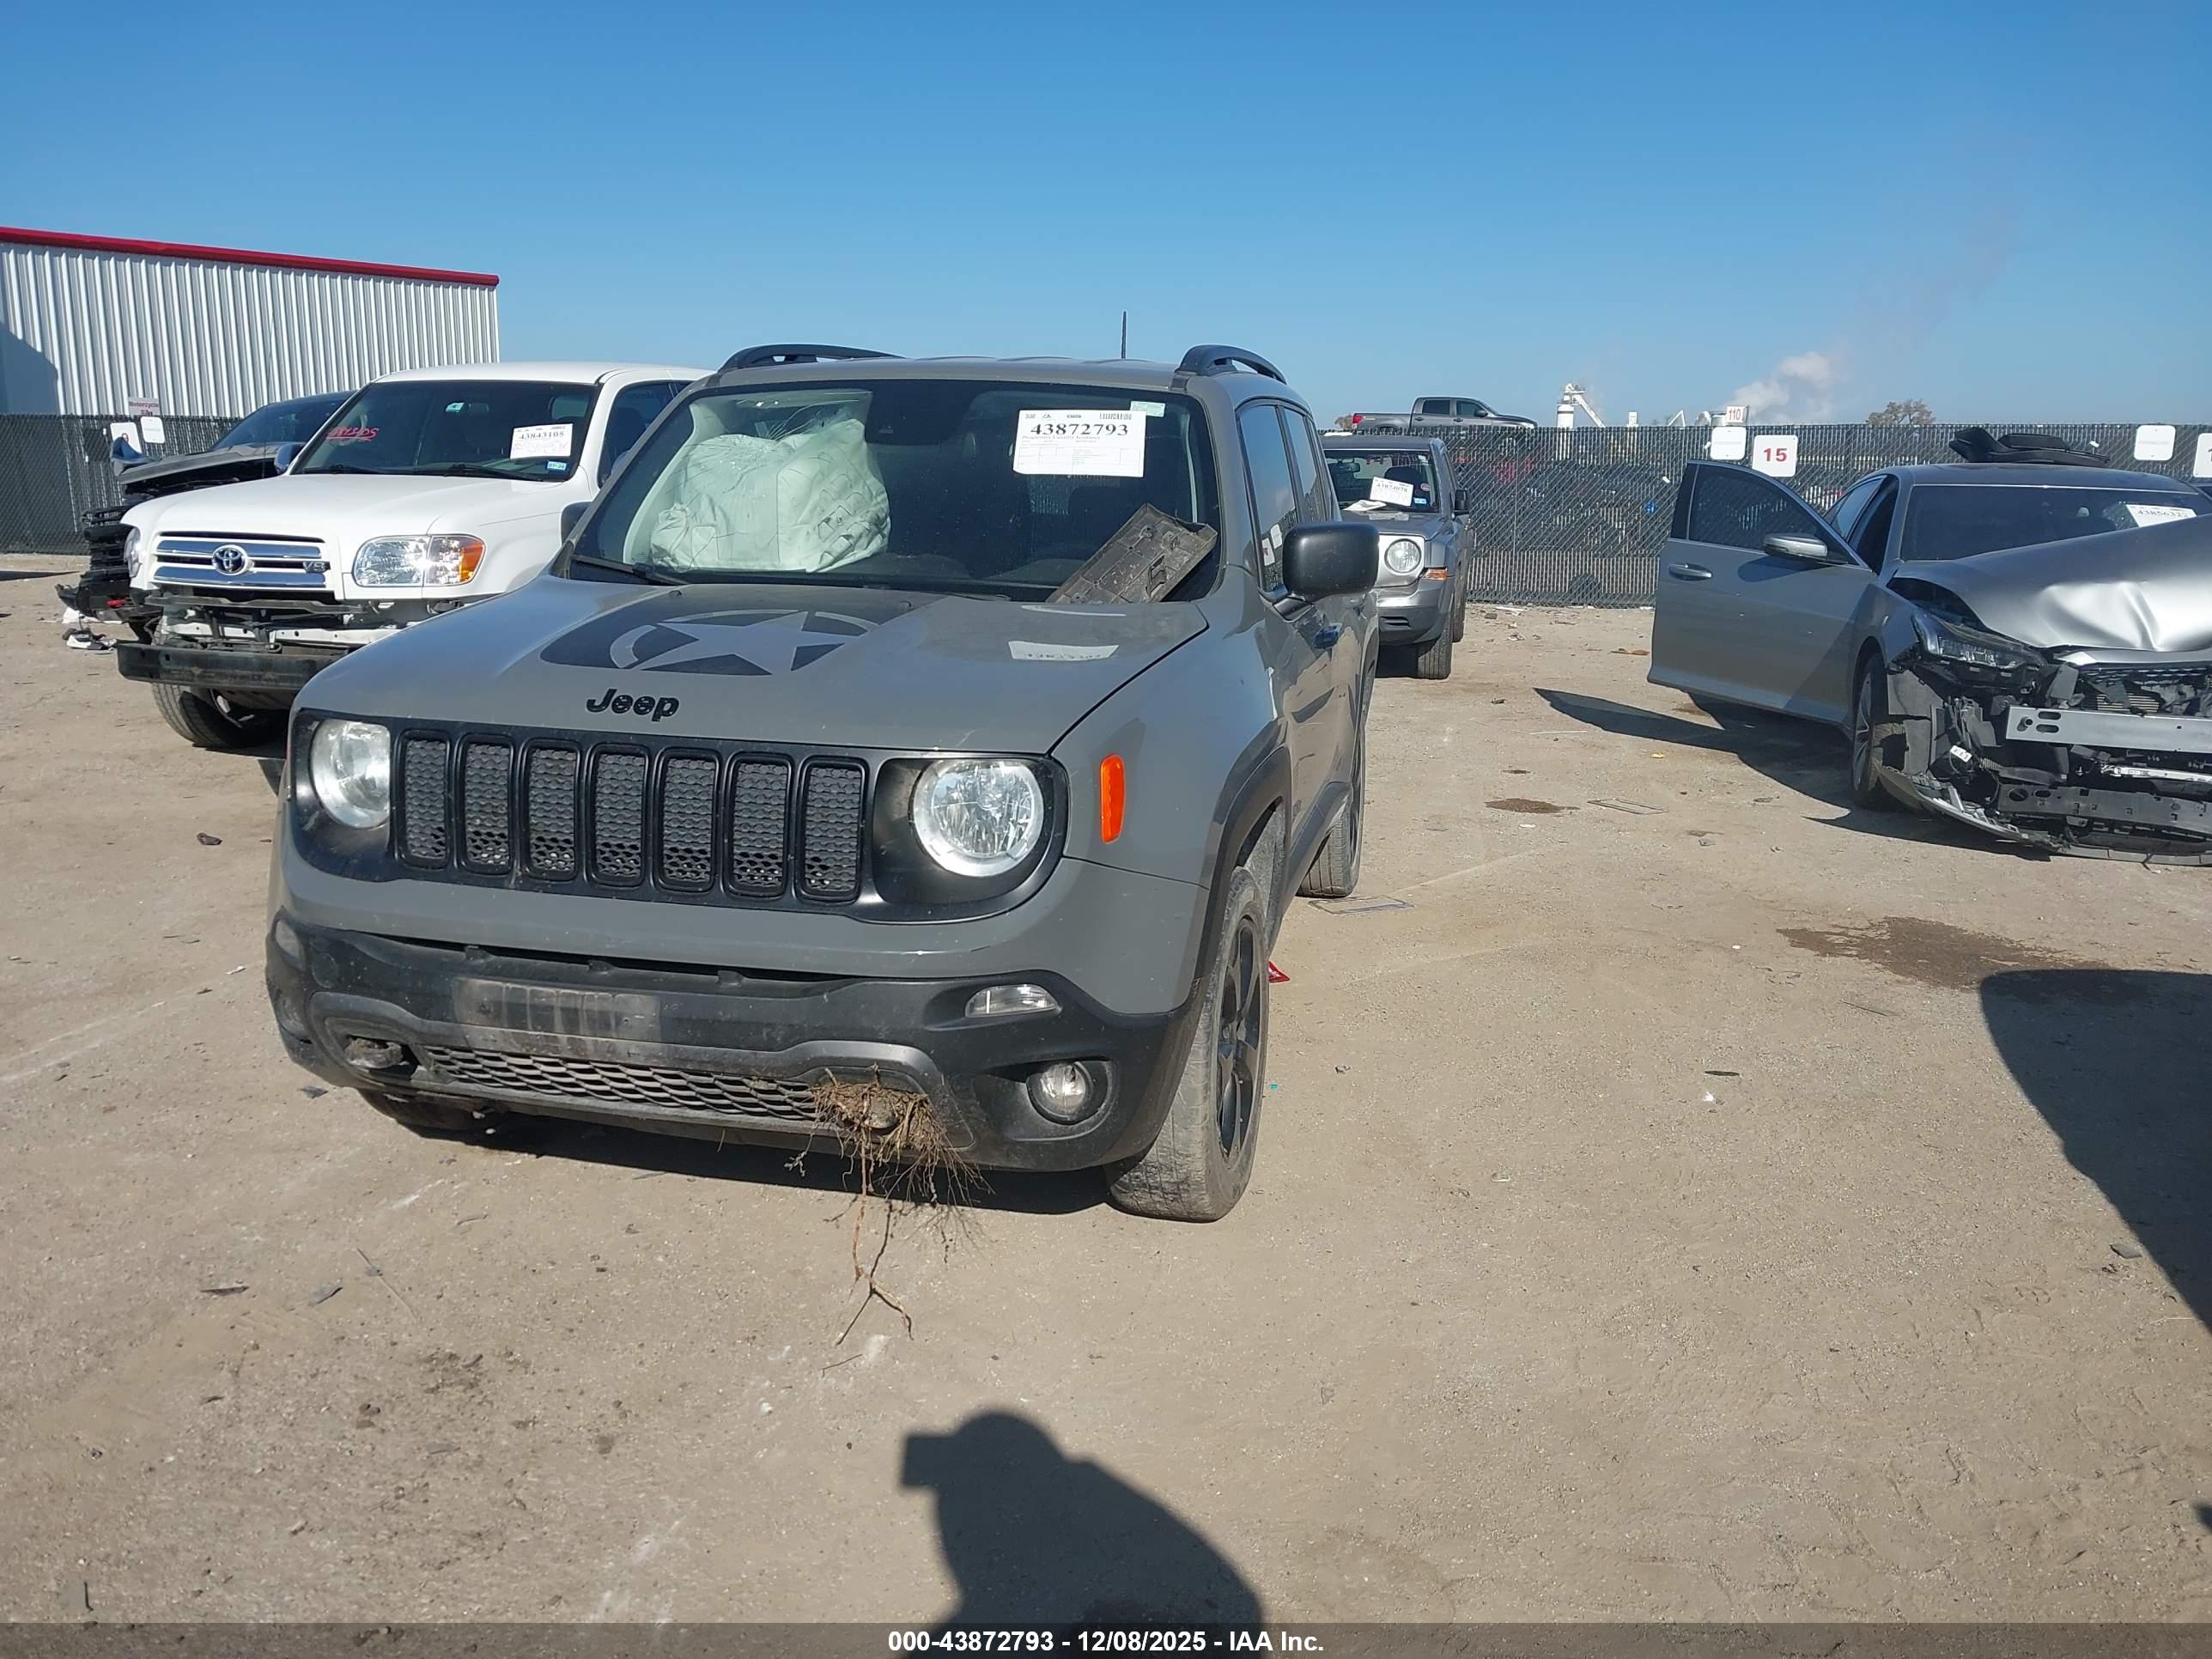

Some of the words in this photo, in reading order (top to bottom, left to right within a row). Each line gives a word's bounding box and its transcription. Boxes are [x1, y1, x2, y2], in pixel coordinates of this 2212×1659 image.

[1729, 408, 1741, 421] 110
[1030, 423, 1128, 435] 43872793
[1764, 448, 1788, 462] 15
[586, 688, 679, 722] Jeep
